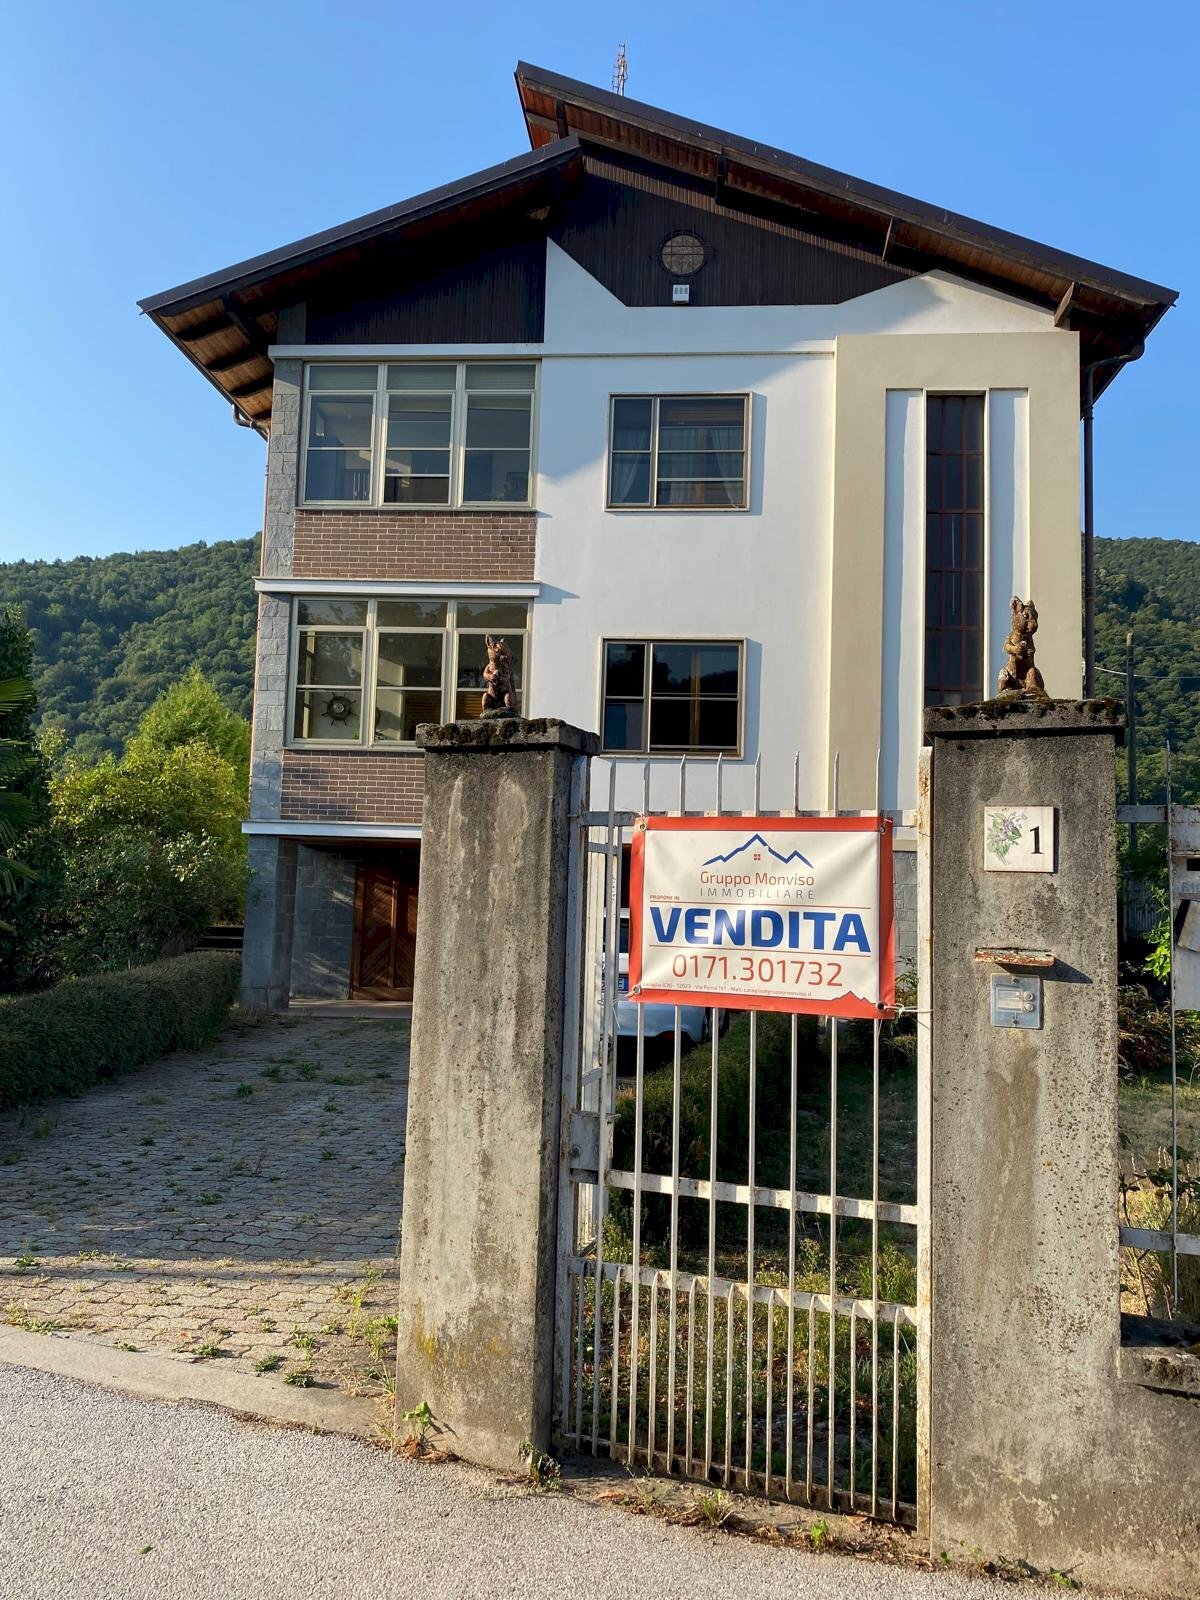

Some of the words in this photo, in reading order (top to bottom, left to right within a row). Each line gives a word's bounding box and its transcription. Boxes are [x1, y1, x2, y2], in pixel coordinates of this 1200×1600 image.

[1029, 825, 1044, 855] 1
[700, 871, 751, 887] Gruppo
[755, 872, 815, 886] Monviso
[700, 887, 815, 900] IMMOBILIARE
[649, 906, 872, 953] VENDITA
[672, 954, 843, 987] 0171.301732
